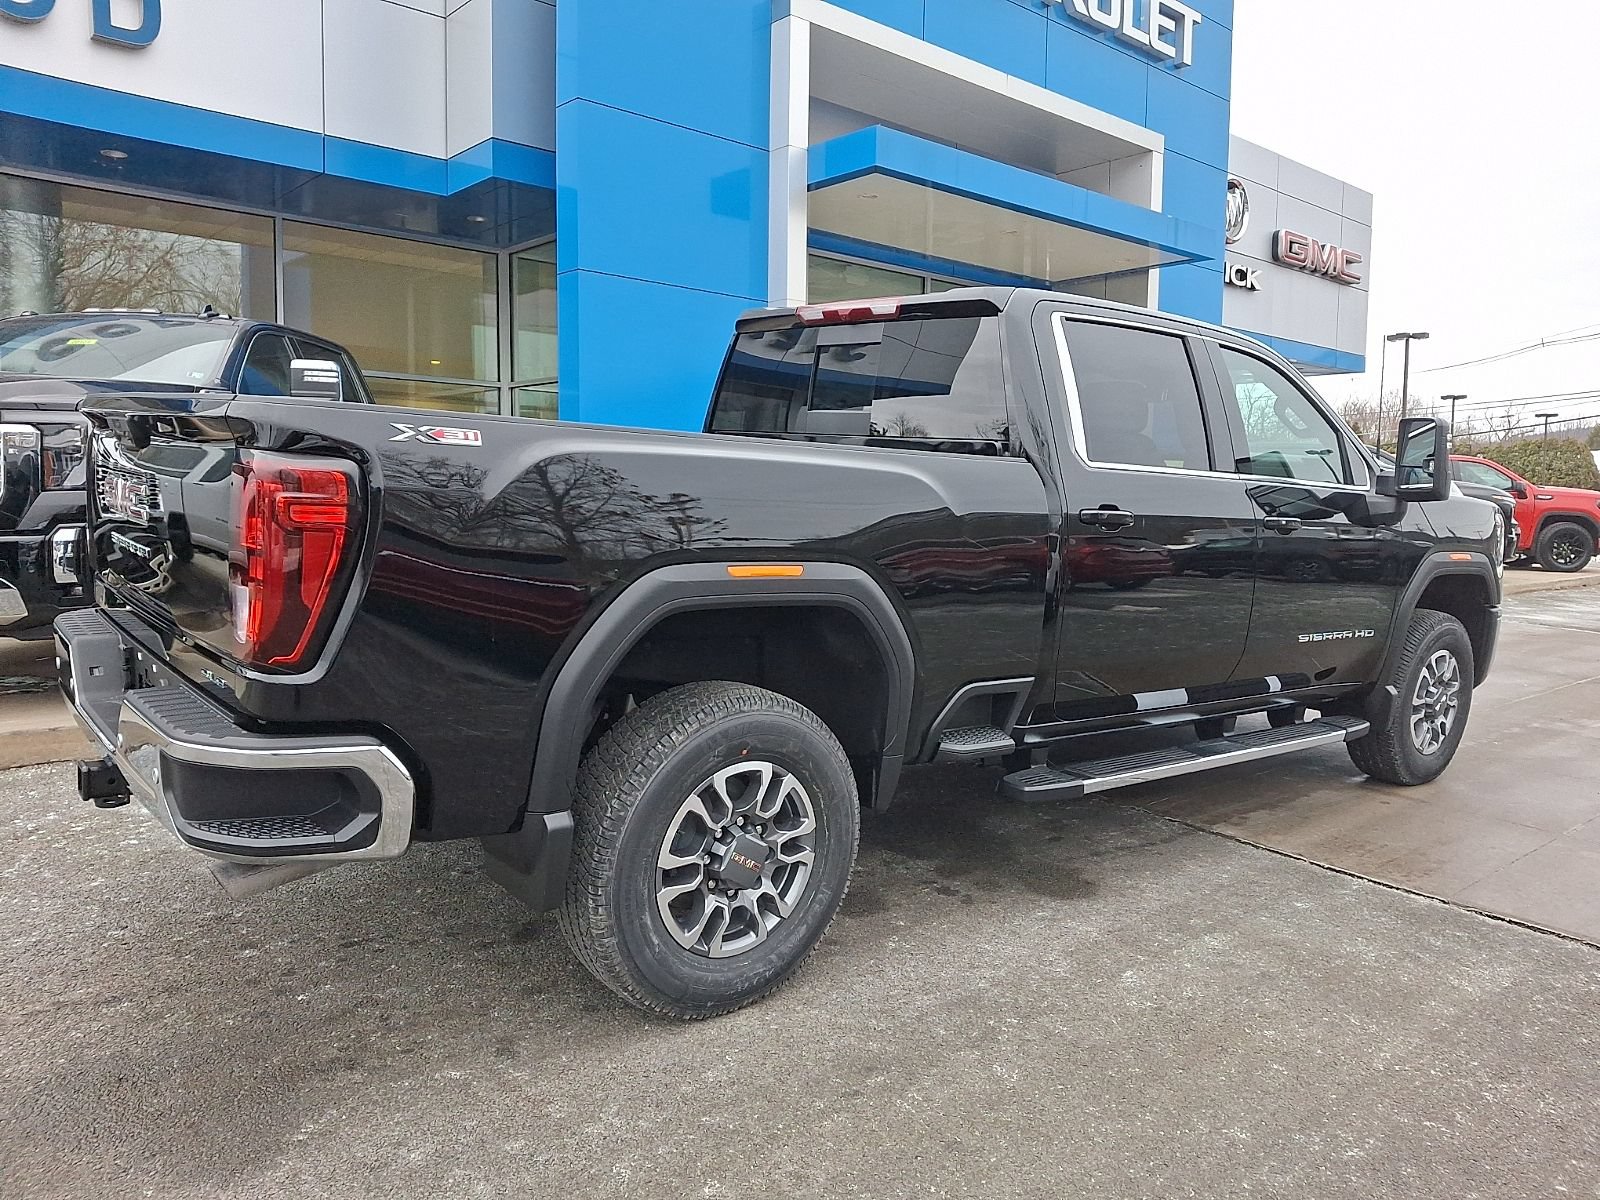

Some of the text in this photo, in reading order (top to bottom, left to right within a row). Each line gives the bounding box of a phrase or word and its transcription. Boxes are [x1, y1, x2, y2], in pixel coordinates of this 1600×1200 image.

[1273, 229, 1362, 284] GMC
[1298, 629, 1375, 643] SIERRA HD
[730, 851, 763, 873] GMC
